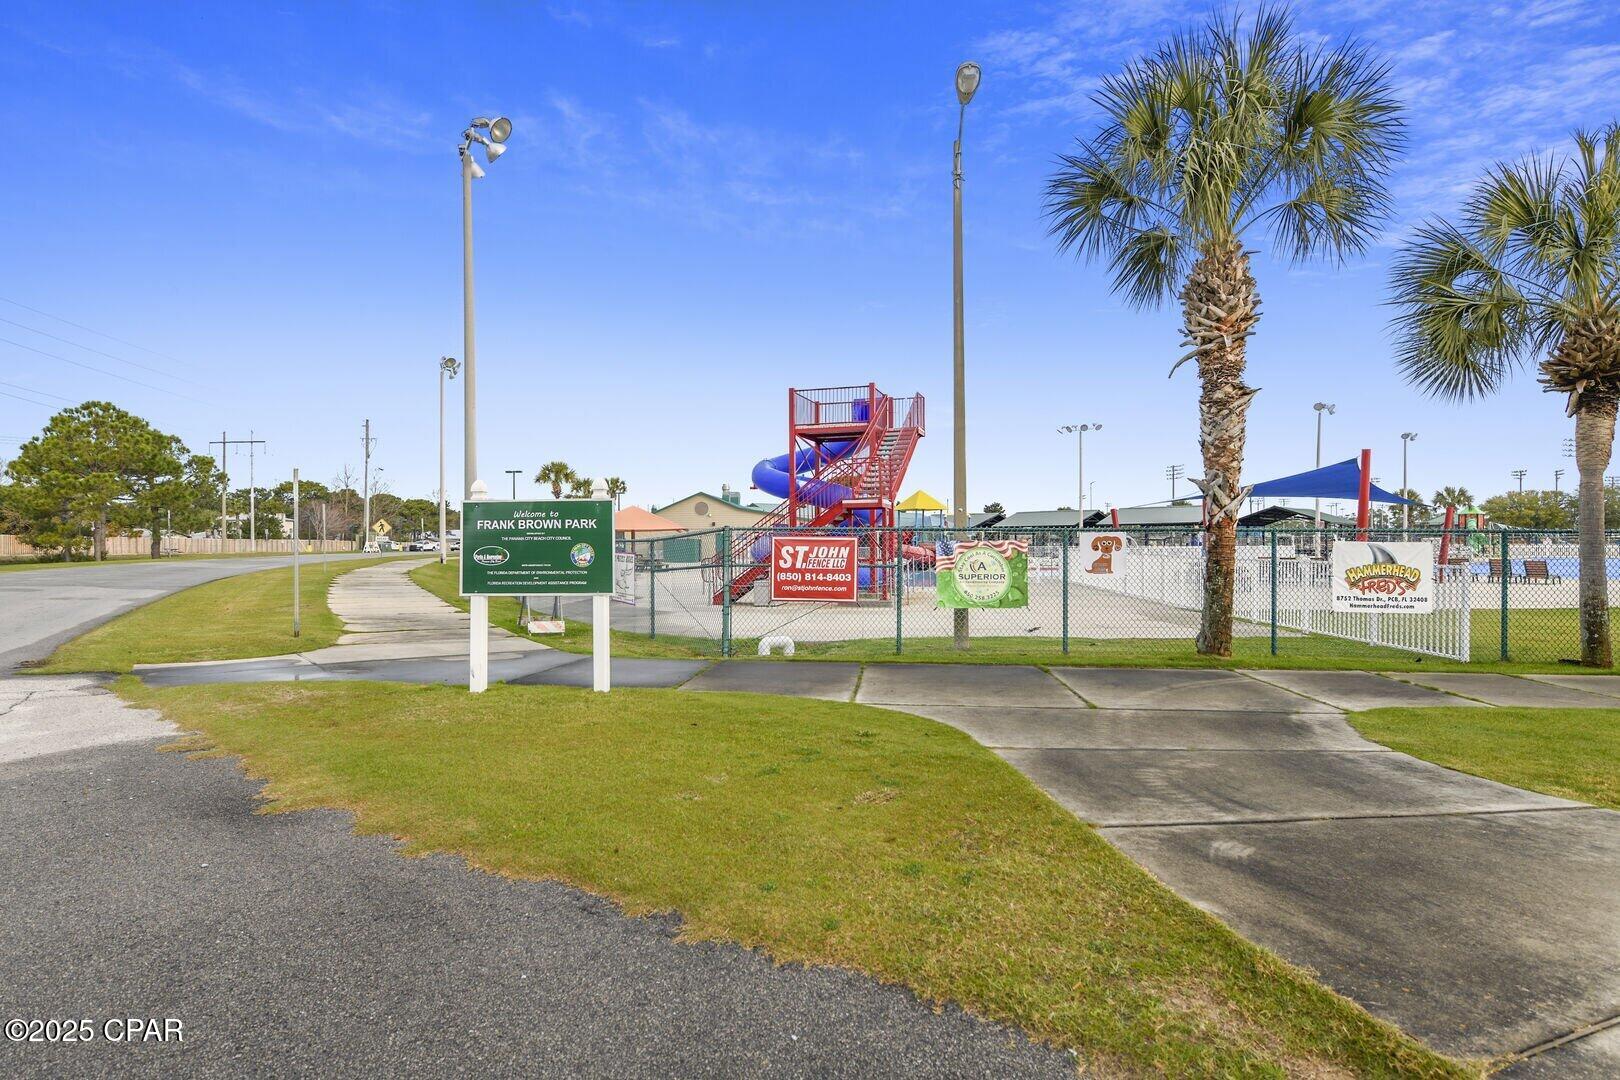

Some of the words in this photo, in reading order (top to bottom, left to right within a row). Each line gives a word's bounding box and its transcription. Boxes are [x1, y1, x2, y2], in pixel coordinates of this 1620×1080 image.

[477, 520, 515, 530] FRANK
[518, 520, 562, 530] BROWN
[565, 519, 597, 528] PARK
[779, 546, 809, 569] ST.
[809, 547, 850, 558] JOHN
[807, 558, 830, 568] FENCE
[832, 558, 846, 568] LLC
[777, 572, 802, 582] (850)
[805, 573, 851, 581] 814-8403
[1346, 564, 1421, 582] HAMMERHEAD
